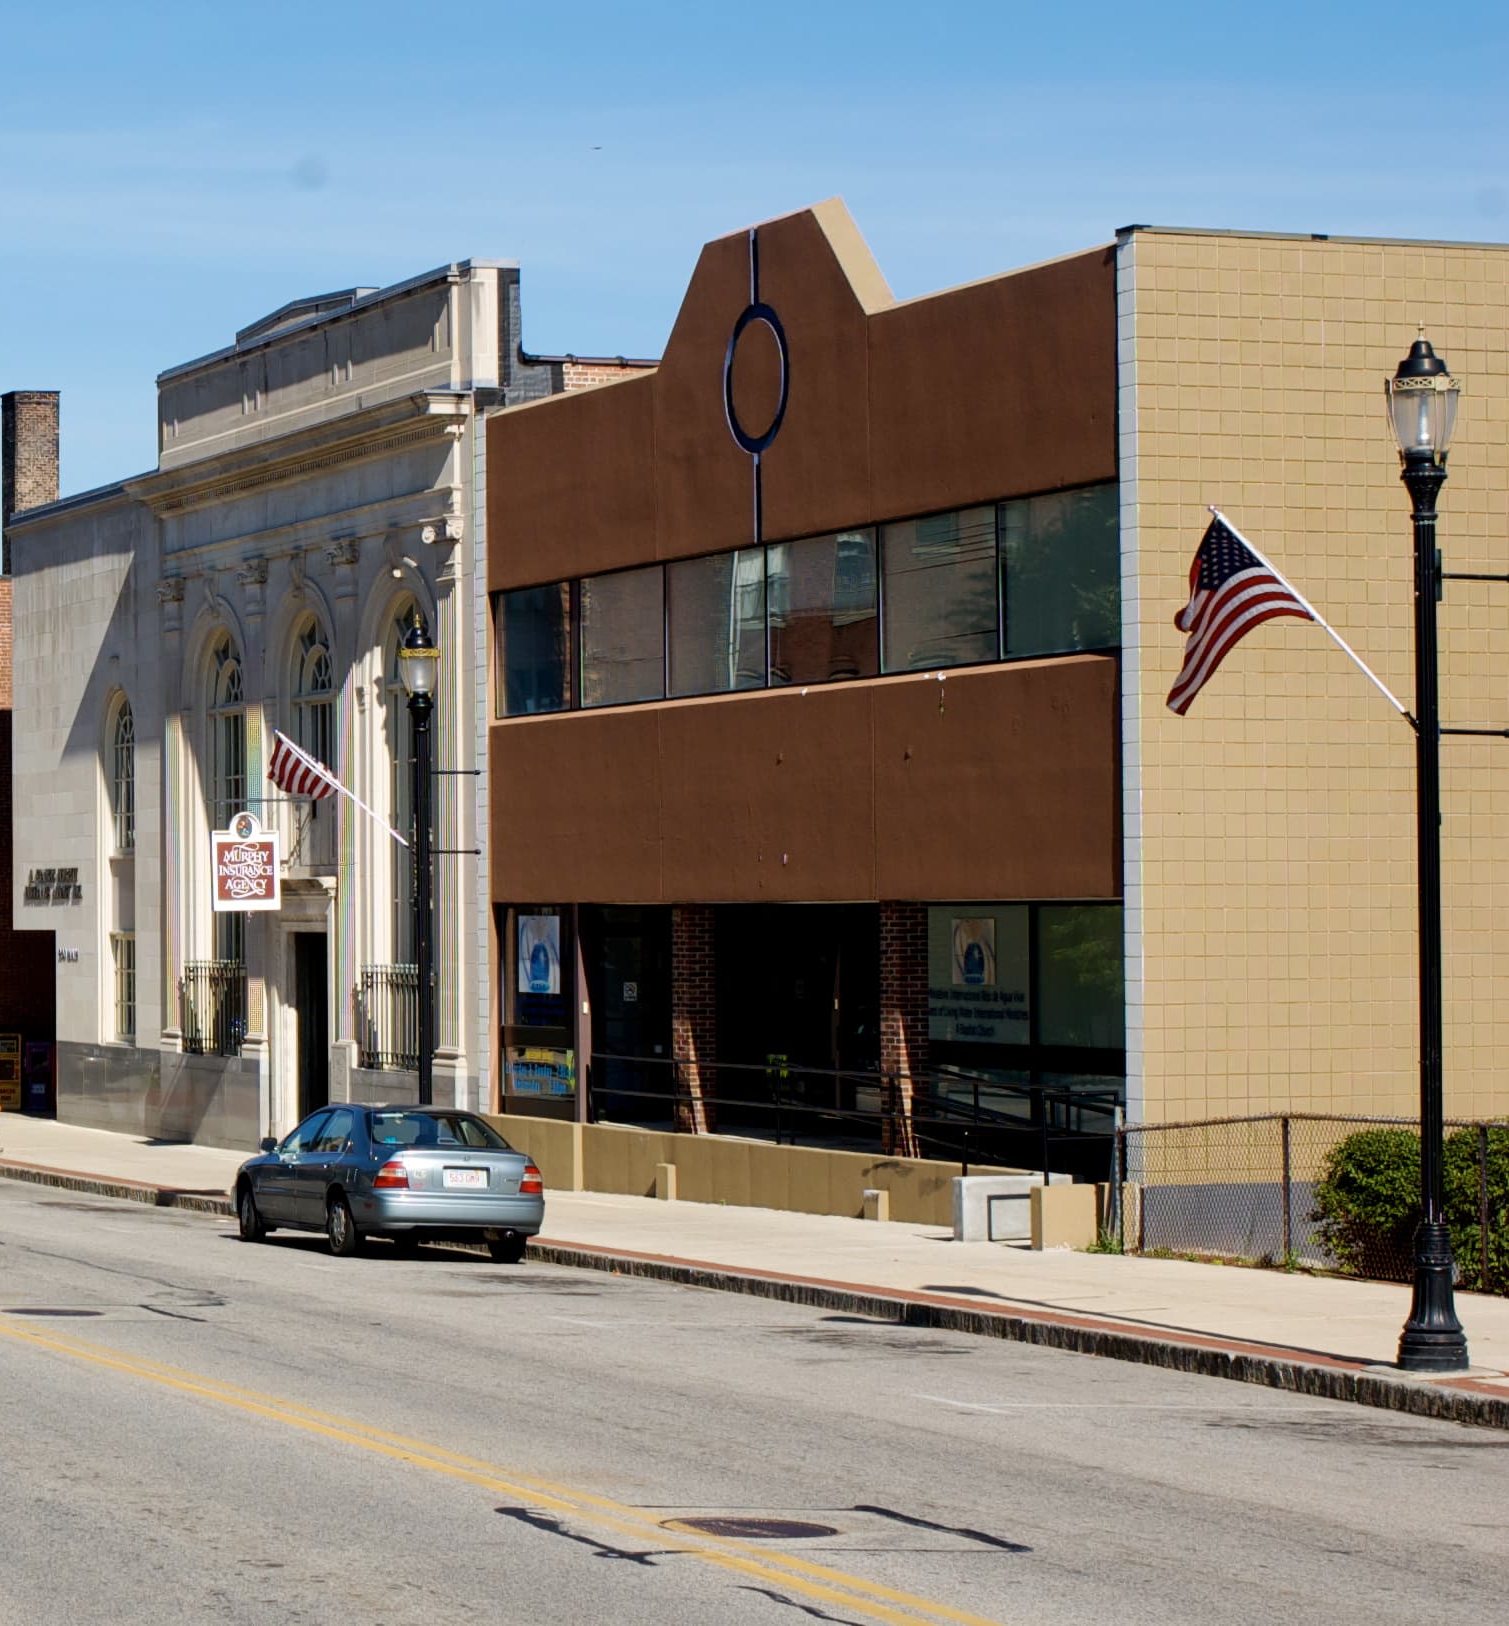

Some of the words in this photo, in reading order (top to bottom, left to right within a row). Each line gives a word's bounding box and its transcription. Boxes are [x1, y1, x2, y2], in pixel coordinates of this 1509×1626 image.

[223, 845, 270, 863] MURPHY
[218, 864, 274, 877] INSURANCE
[225, 878, 268, 892] AGENCY
